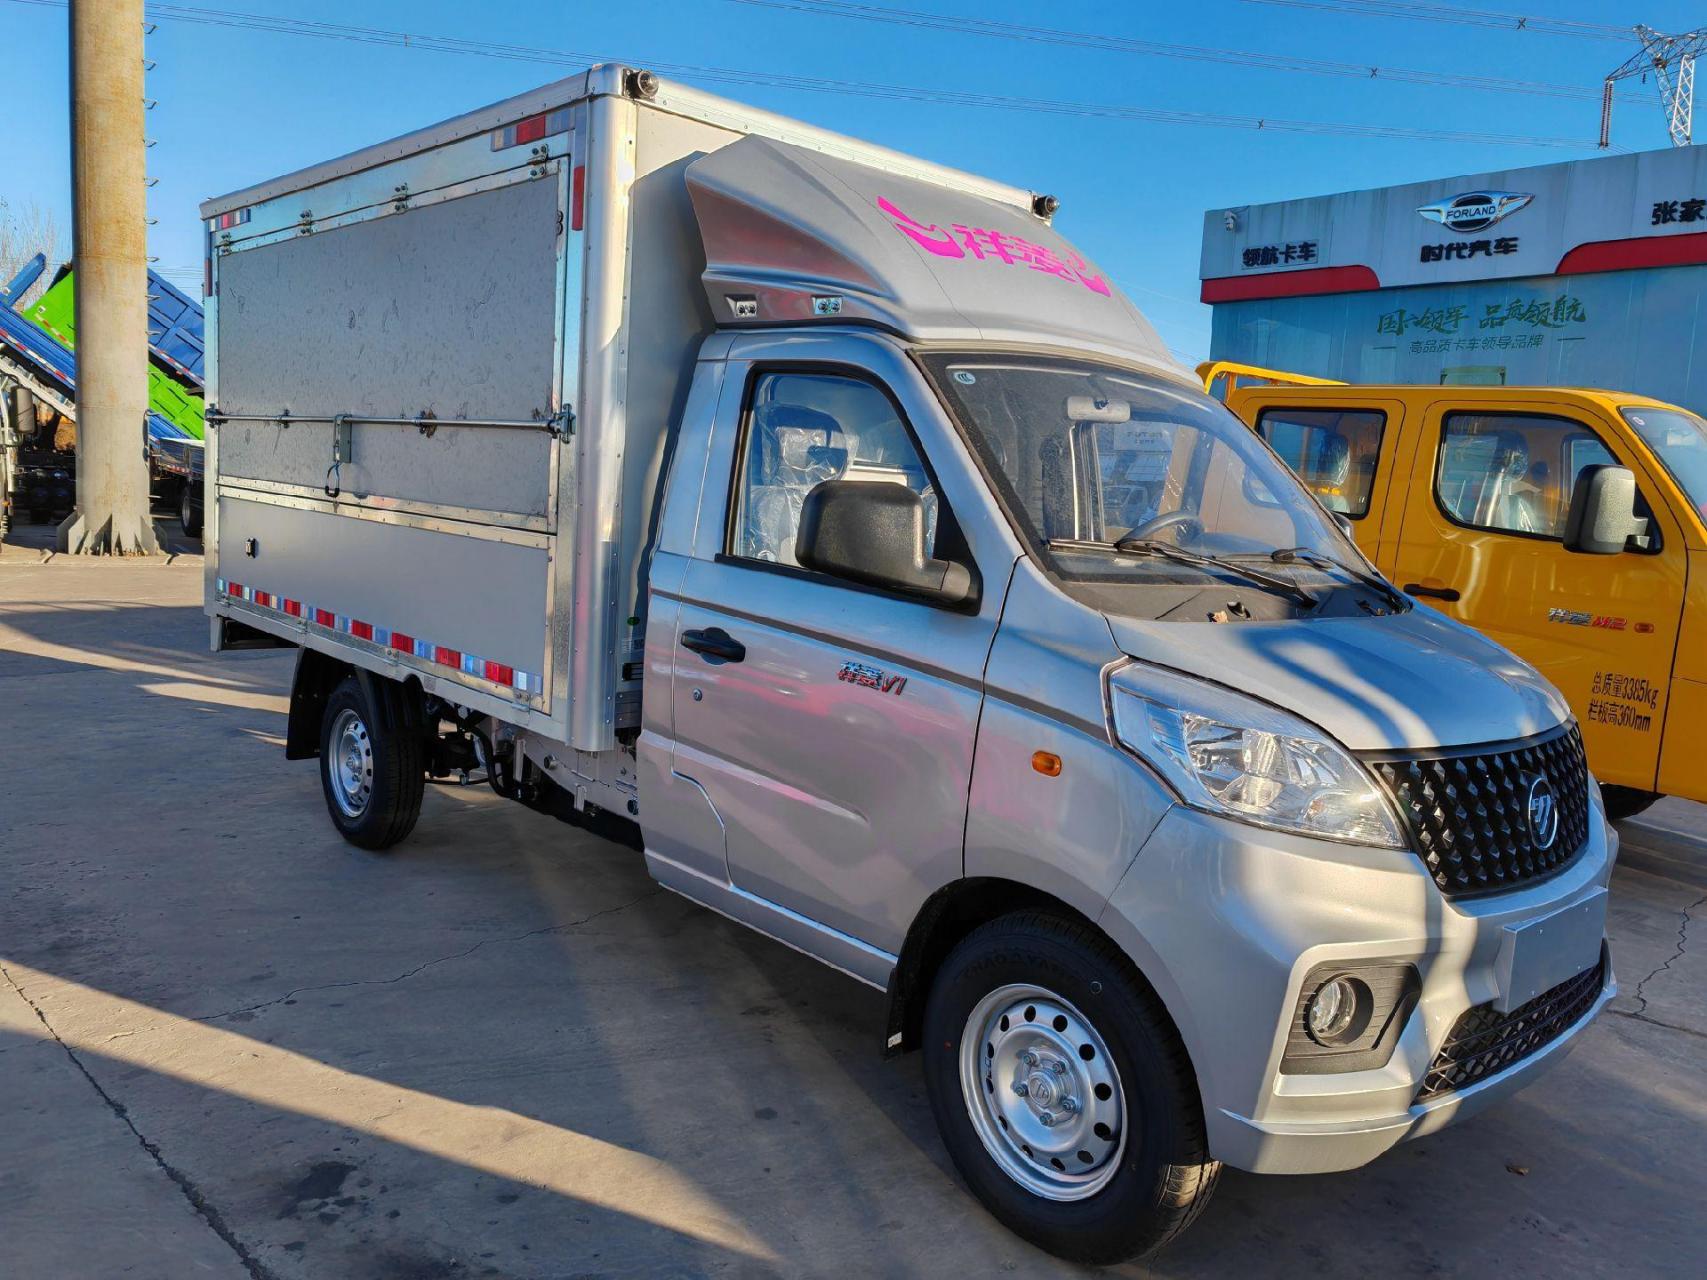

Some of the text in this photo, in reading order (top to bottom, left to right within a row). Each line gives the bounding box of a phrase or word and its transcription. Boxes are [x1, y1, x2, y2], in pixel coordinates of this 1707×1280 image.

[1446, 205, 1496, 219] FORLAND
[1243, 243, 1316, 266] 领航卡车
[1421, 237, 1518, 262] 时代汽车
[1479, 295, 1587, 327] 品质领航
